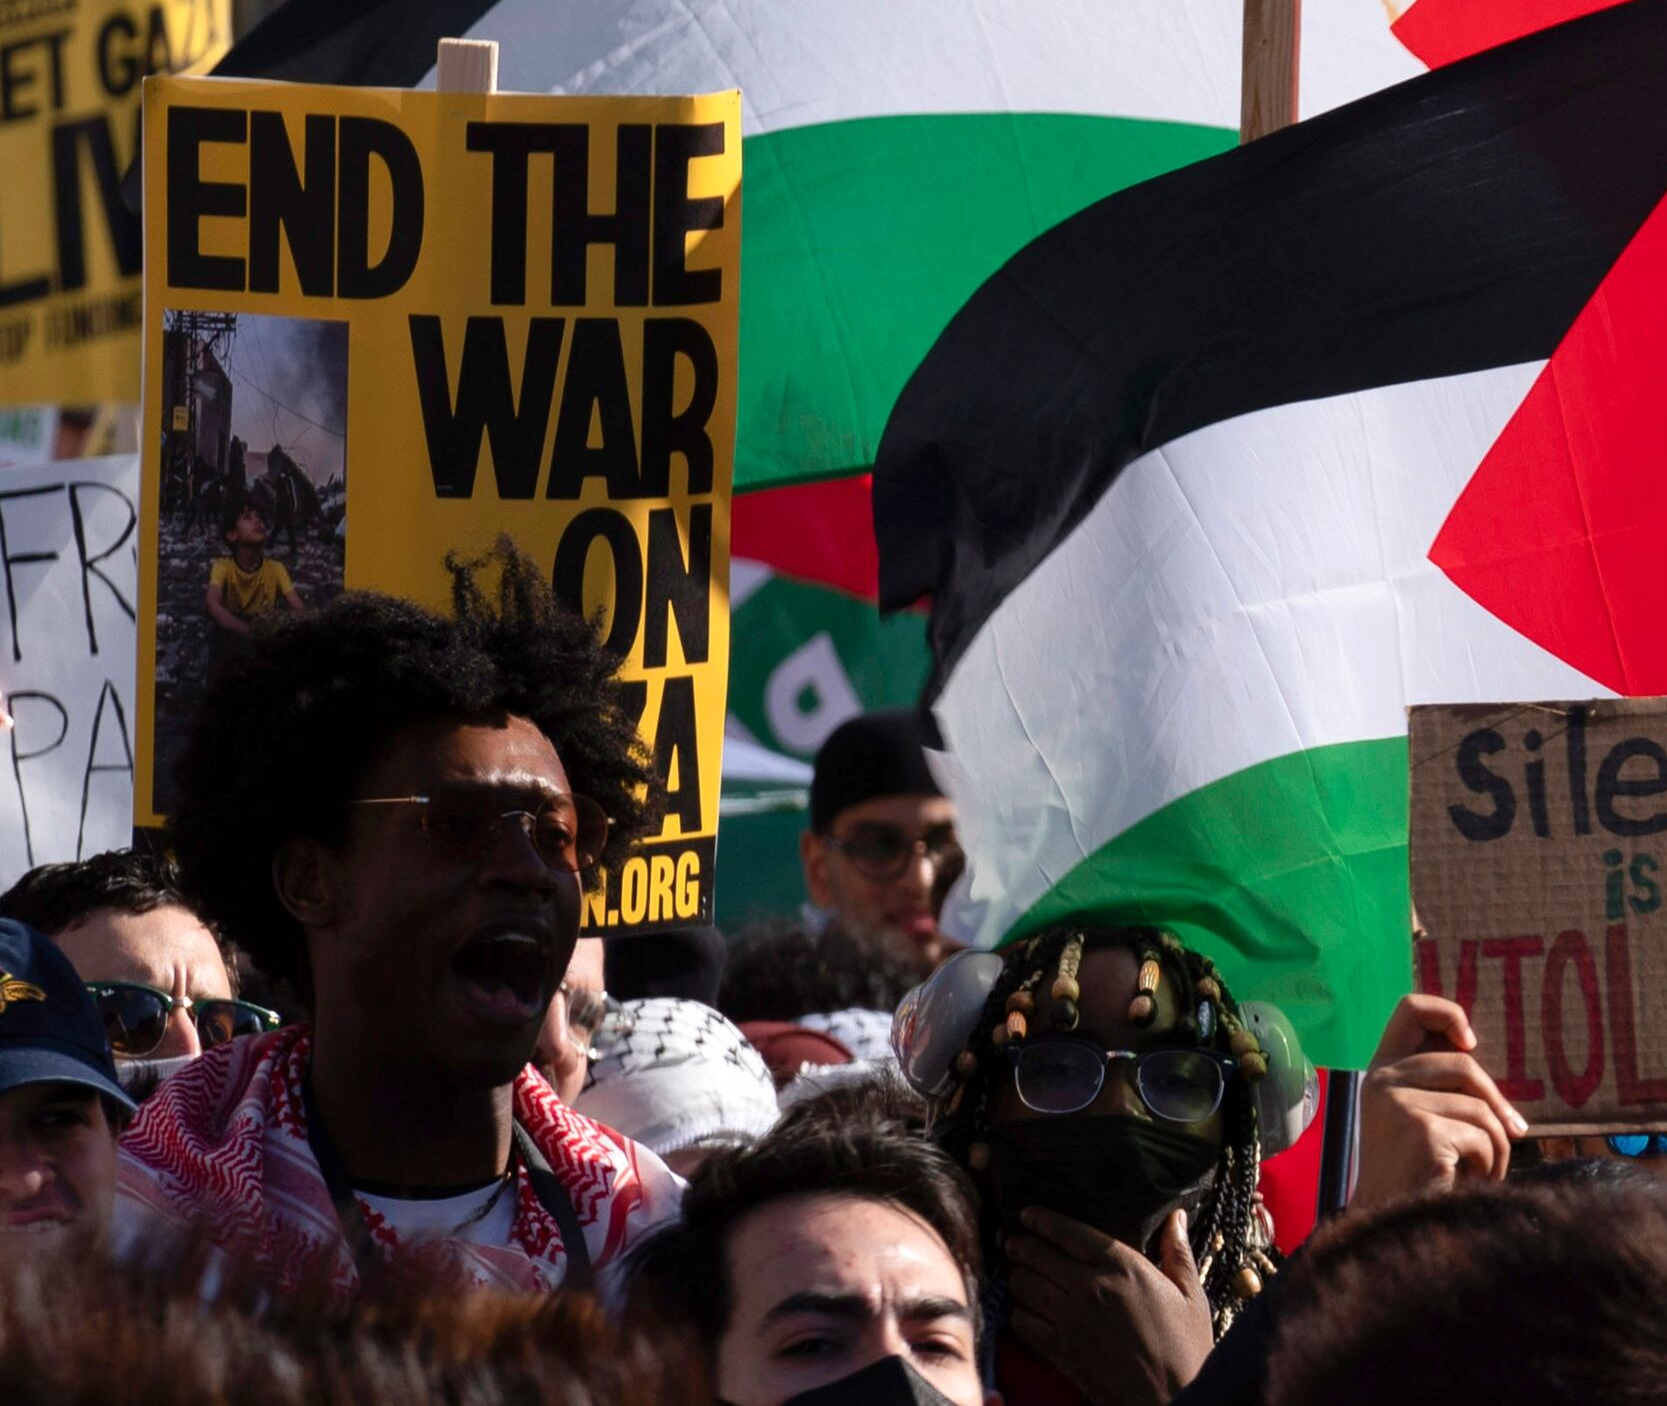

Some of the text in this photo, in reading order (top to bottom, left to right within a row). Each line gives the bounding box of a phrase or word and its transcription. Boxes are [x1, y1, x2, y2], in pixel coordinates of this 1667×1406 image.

[167, 105, 725, 307] END THE
[408, 314, 718, 500] WAR
[551, 502, 713, 671] ON
[1603, 850, 1662, 919] is
